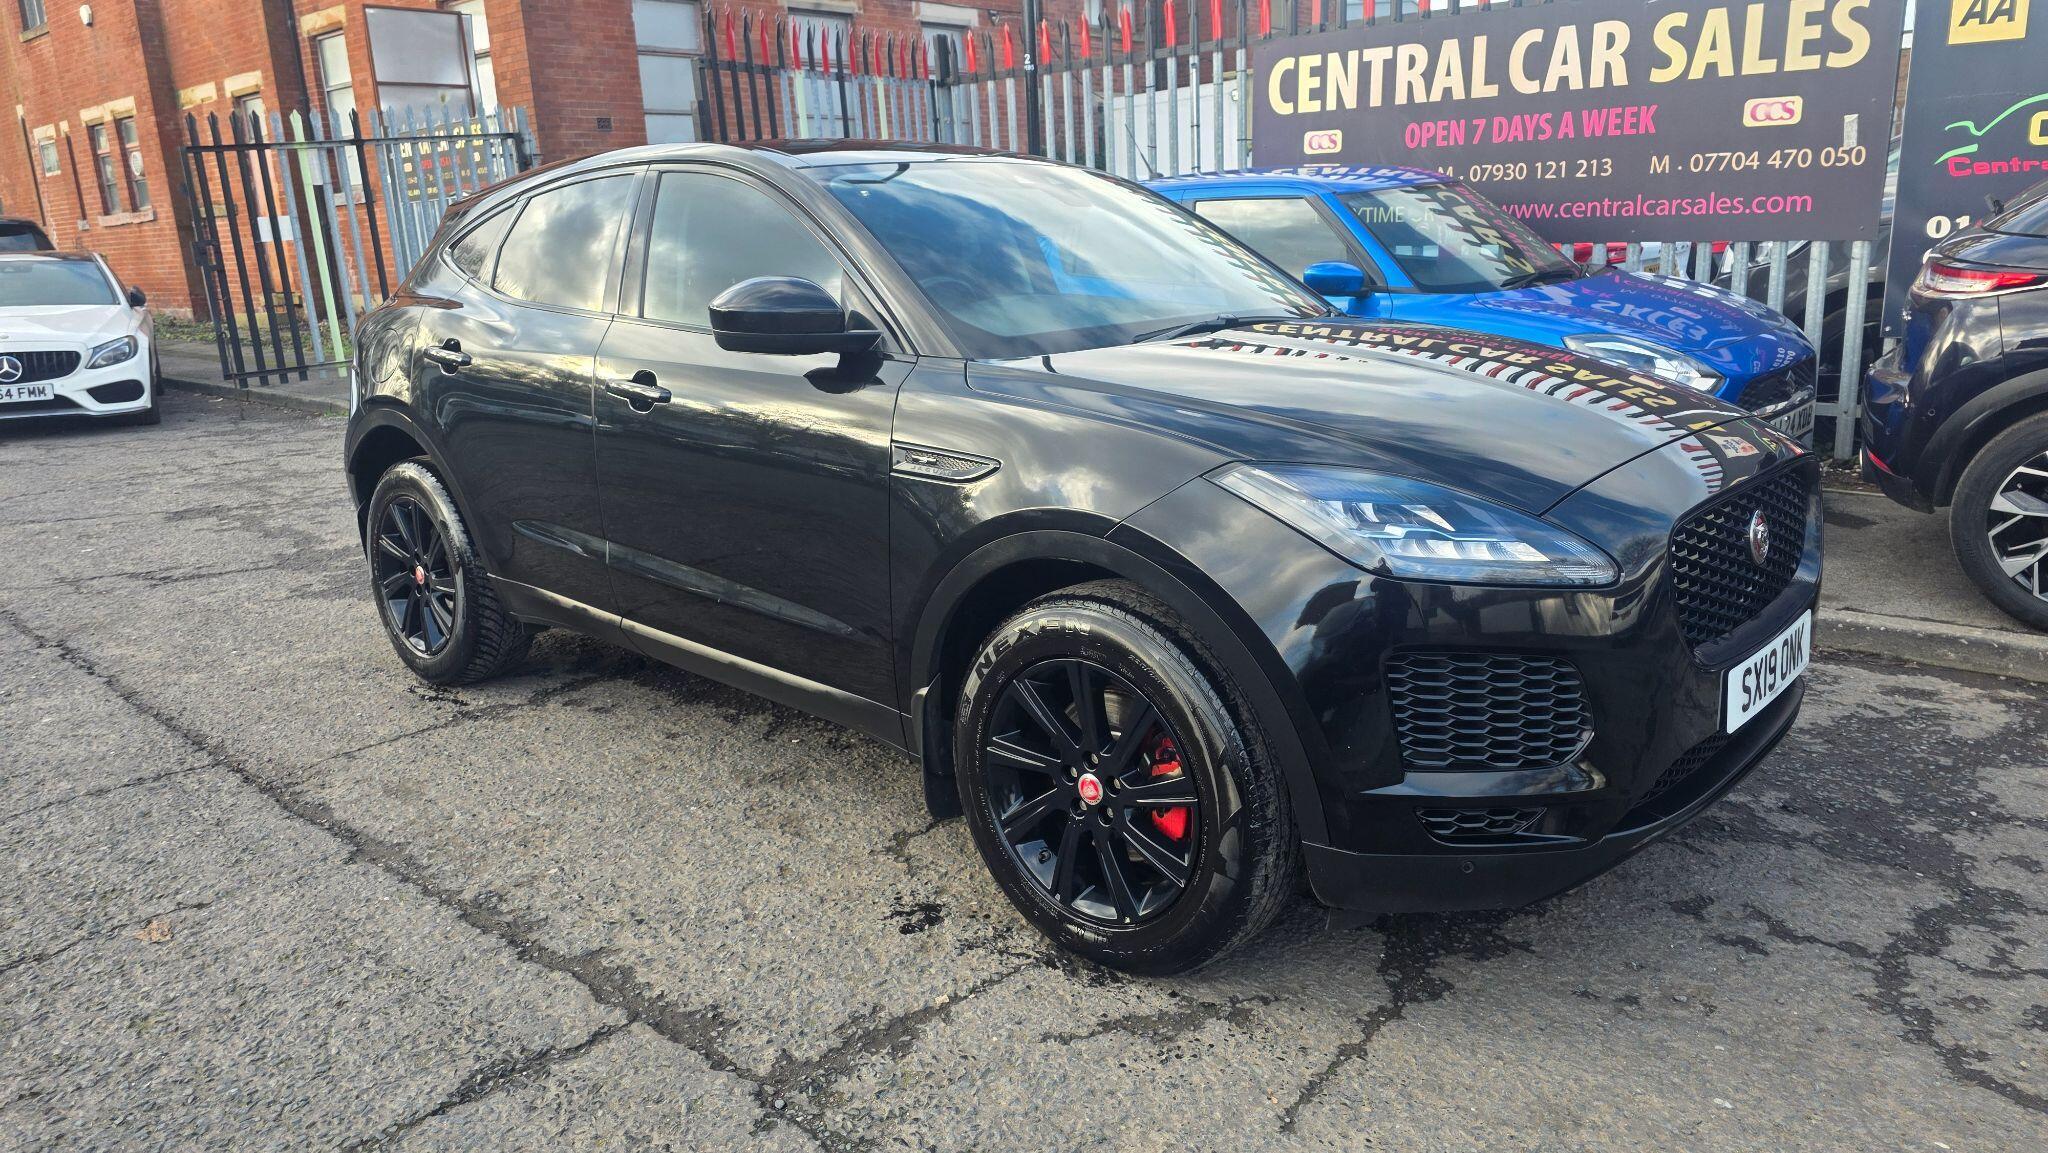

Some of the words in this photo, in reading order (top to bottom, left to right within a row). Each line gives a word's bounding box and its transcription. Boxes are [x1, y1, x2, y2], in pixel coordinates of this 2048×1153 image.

[1958, 0, 2018, 27] AA
[1268, 35, 1499, 115] CENTRAL
[1508, 20, 1631, 94] CAR
[1649, 0, 1871, 83] SALES
[1405, 119, 1466, 149] OPEN
[1472, 118, 1486, 145] 7
[1492, 112, 1553, 144] DAYS
[1557, 111, 1575, 139] A
[1581, 104, 1659, 138] WEEK
[1469, 163, 1527, 182] 07930
[1535, 160, 1567, 179] 121
[1575, 157, 1613, 178] 213
[1649, 154, 1670, 174] M
[1690, 151, 1760, 173] 07704
[1767, 148, 1813, 169] 470
[1820, 145, 1867, 167] 050
[1353, 206, 1404, 224] YTIME
[1502, 191, 1813, 219] www.centralcarsales.com
[17, 385, 47, 399] FMM
[1741, 648, 1778, 713] SX19
[1780, 622, 1805, 682] ONK
